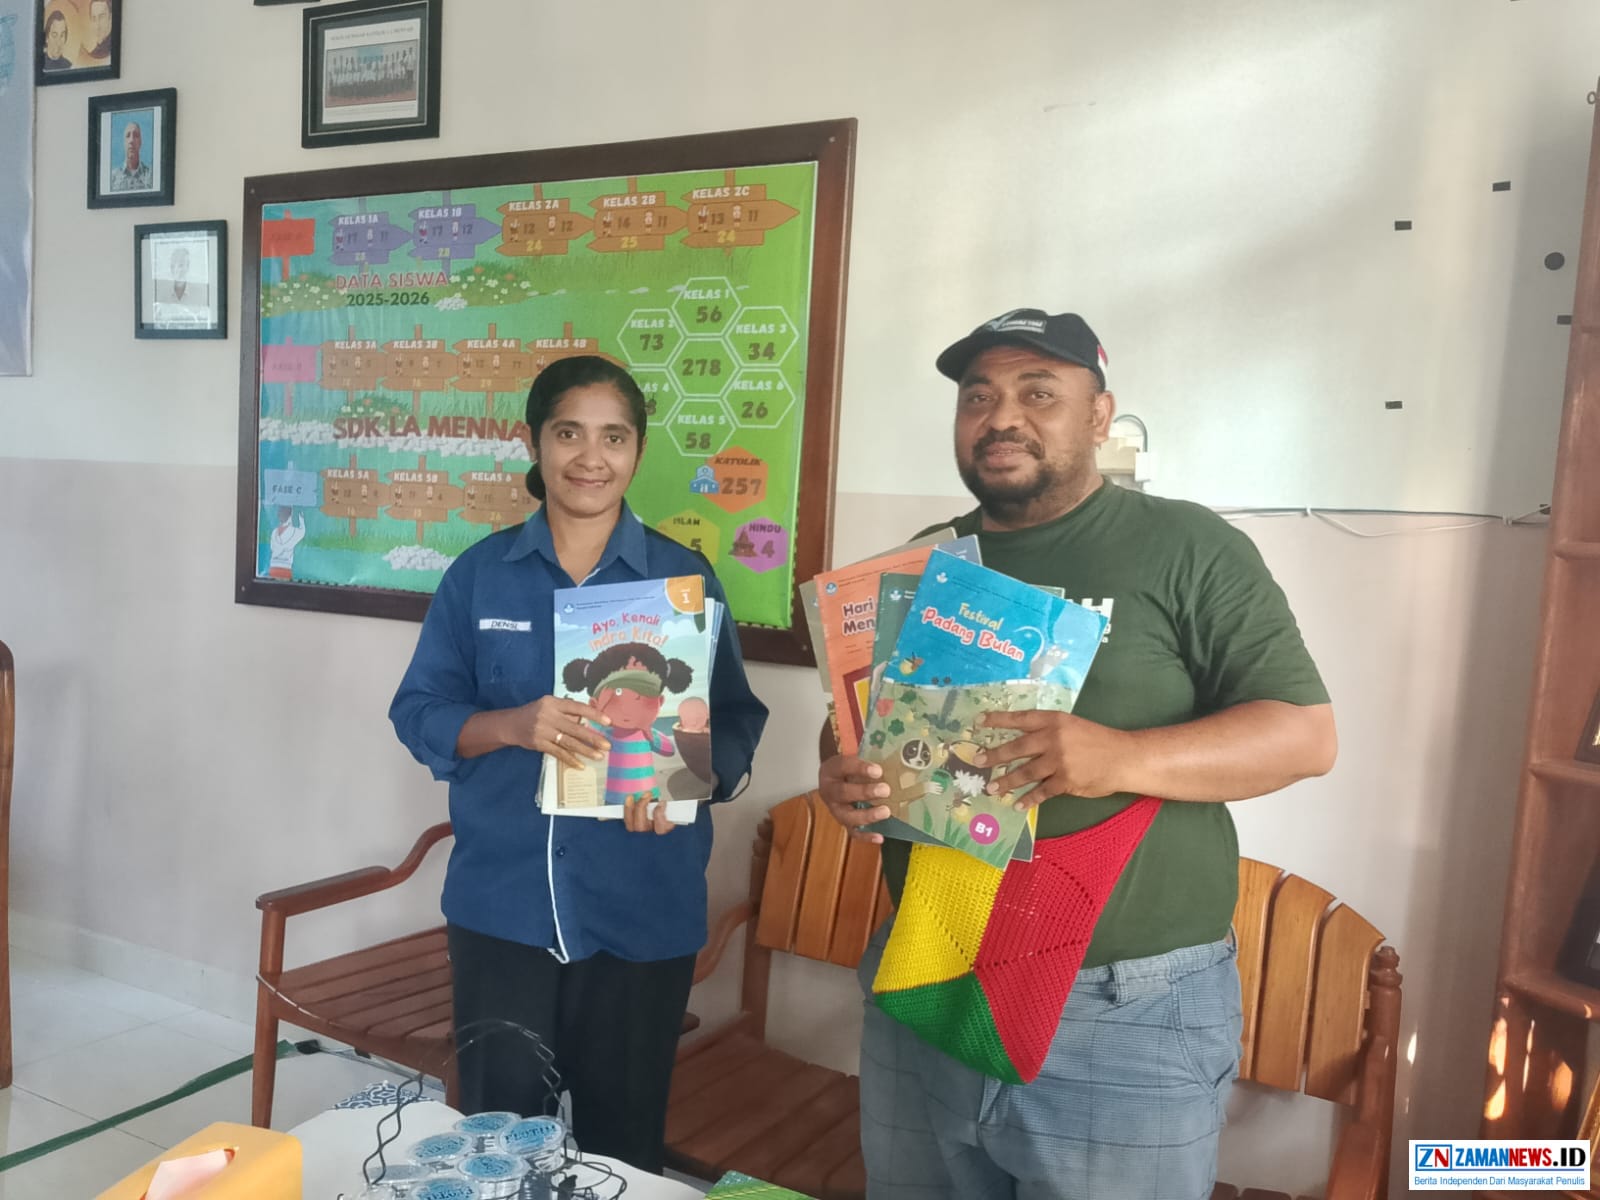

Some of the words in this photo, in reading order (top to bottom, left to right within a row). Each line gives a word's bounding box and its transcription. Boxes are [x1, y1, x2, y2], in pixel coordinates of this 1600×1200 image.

[692, 188, 730, 199] KELAS
[734, 186, 750, 196] 2C
[508, 200, 542, 212] KELAS
[545, 200, 559, 209] 2A
[603, 196, 638, 208] KELAS
[641, 195, 656, 205] 2B
[338, 215, 366, 225] KELAS
[368, 214, 379, 224] 1A
[418, 208, 449, 219] KELAS
[452, 208, 462, 218] 1B
[336, 274, 382, 290] DATA
[388, 271, 449, 288] SISWA
[347, 291, 430, 306] 2025-2026
[684, 289, 721, 300] KELAS
[725, 288, 731, 298] 1
[696, 306, 722, 324] 56
[631, 320, 664, 328] KELAS
[736, 324, 772, 334] KELAS
[335, 341, 361, 350] KELAS
[365, 340, 377, 350] 3A
[393, 340, 422, 349] KELAS
[425, 340, 438, 350] 3B
[467, 340, 499, 348] KELAS
[502, 340, 516, 348] 4A
[536, 339, 568, 348] KELAS
[572, 338, 587, 348] 4B
[640, 334, 664, 351] 73
[748, 342, 776, 360] 34
[682, 358, 722, 376] 278
[734, 380, 772, 390] KELAS
[742, 401, 768, 418] 26
[678, 414, 715, 425] KELAS
[333, 416, 383, 440] SDK
[389, 416, 422, 437] LA
[685, 432, 712, 450] 58
[714, 457, 762, 466] KATOLIK
[327, 469, 354, 479] KELAS
[357, 470, 370, 480] 5A
[394, 472, 423, 482] KELAS
[472, 472, 502, 482] KELAS
[721, 478, 762, 496] 257
[673, 517, 700, 526] ISLAM
[749, 524, 782, 534] HINDU
[761, 540, 776, 558] 4
[682, 594, 690, 604] 1
[842, 598, 874, 618] Hari
[622, 612, 661, 626] Kenali
[959, 602, 1004, 631] Festival
[590, 630, 627, 652] Indra
[632, 626, 669, 648] Kita!
[922, 606, 975, 645] Padang
[978, 630, 1024, 662] Bulan
[975, 822, 993, 838] B1
